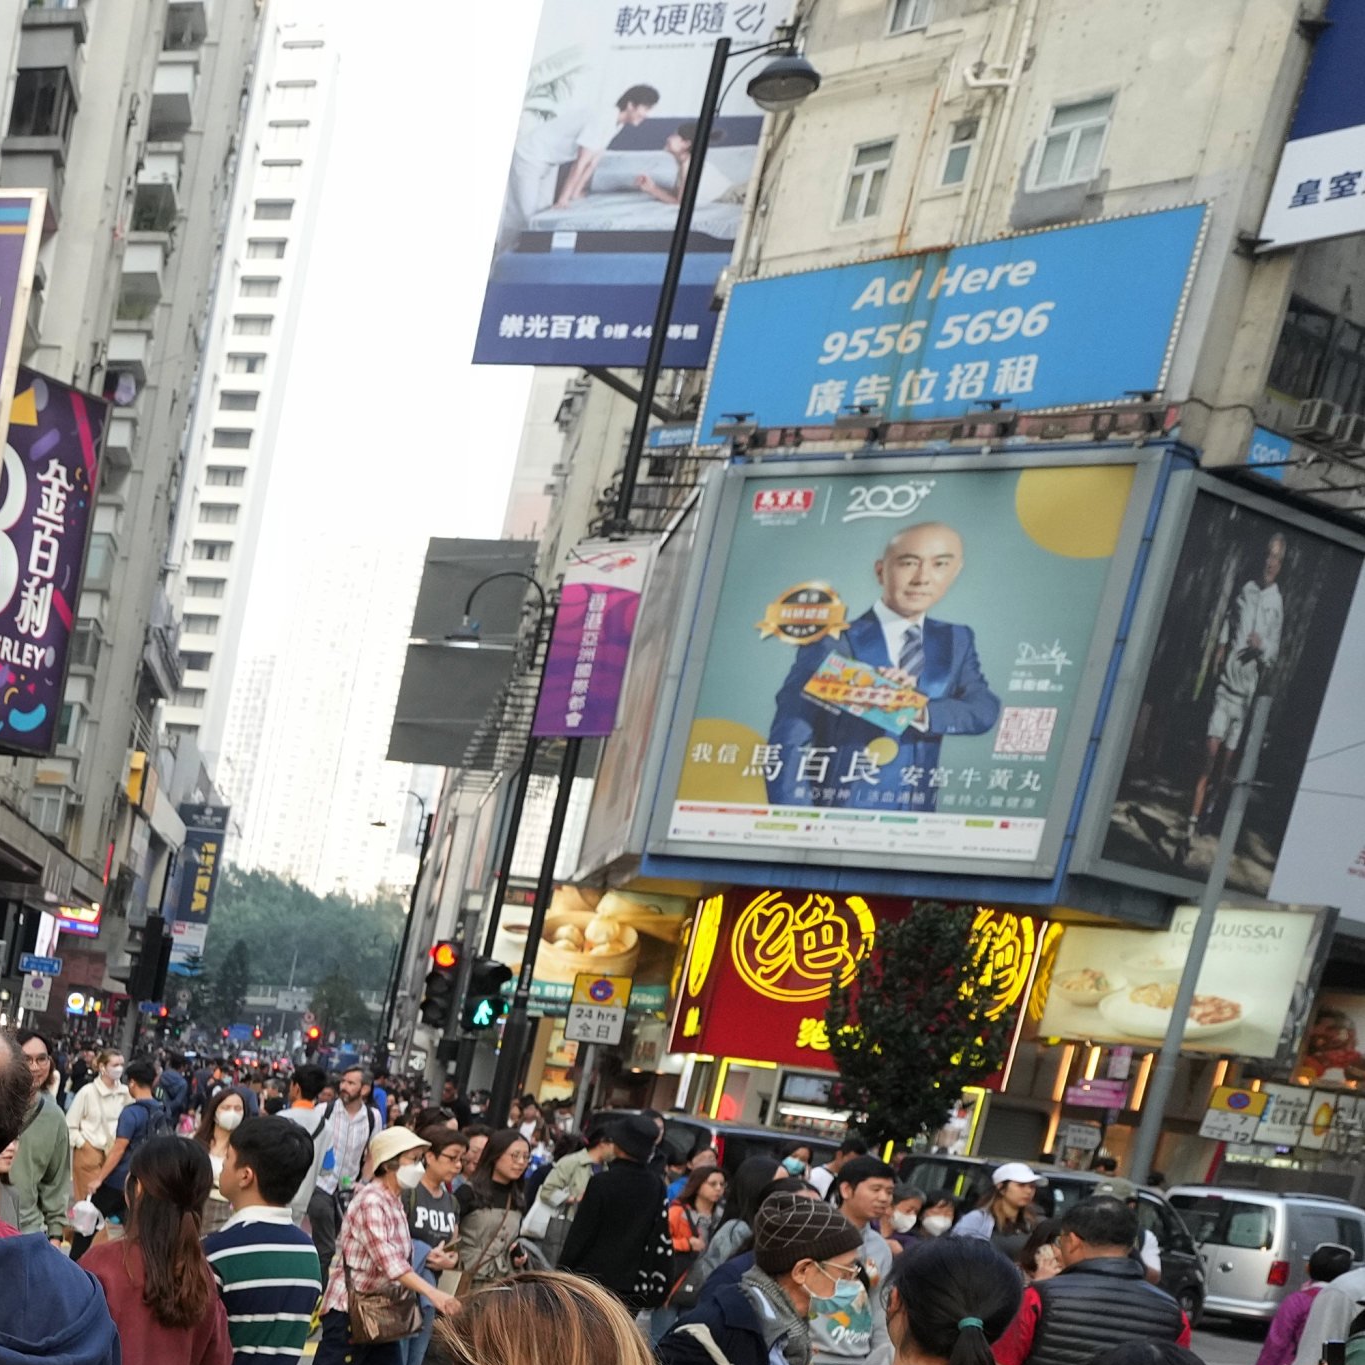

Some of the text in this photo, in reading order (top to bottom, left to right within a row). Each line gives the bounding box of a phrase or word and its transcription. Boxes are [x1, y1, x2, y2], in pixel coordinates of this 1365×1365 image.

[1288, 170, 1365, 209] 皇室
[851, 260, 1037, 311] Ad Here
[499, 314, 600, 340] 崇光百貨
[818, 301, 1055, 365] 9556 5696
[805, 354, 1038, 417] 廣告位招租
[15, 459, 74, 639] 金百利
[690, 743, 740, 765] 我信
[742, 744, 881, 785] 馬百良
[190, 842, 217, 913] IKEA
[575, 1008, 617, 1022] 24 hrs
[576, 1022, 610, 1039] 全日
